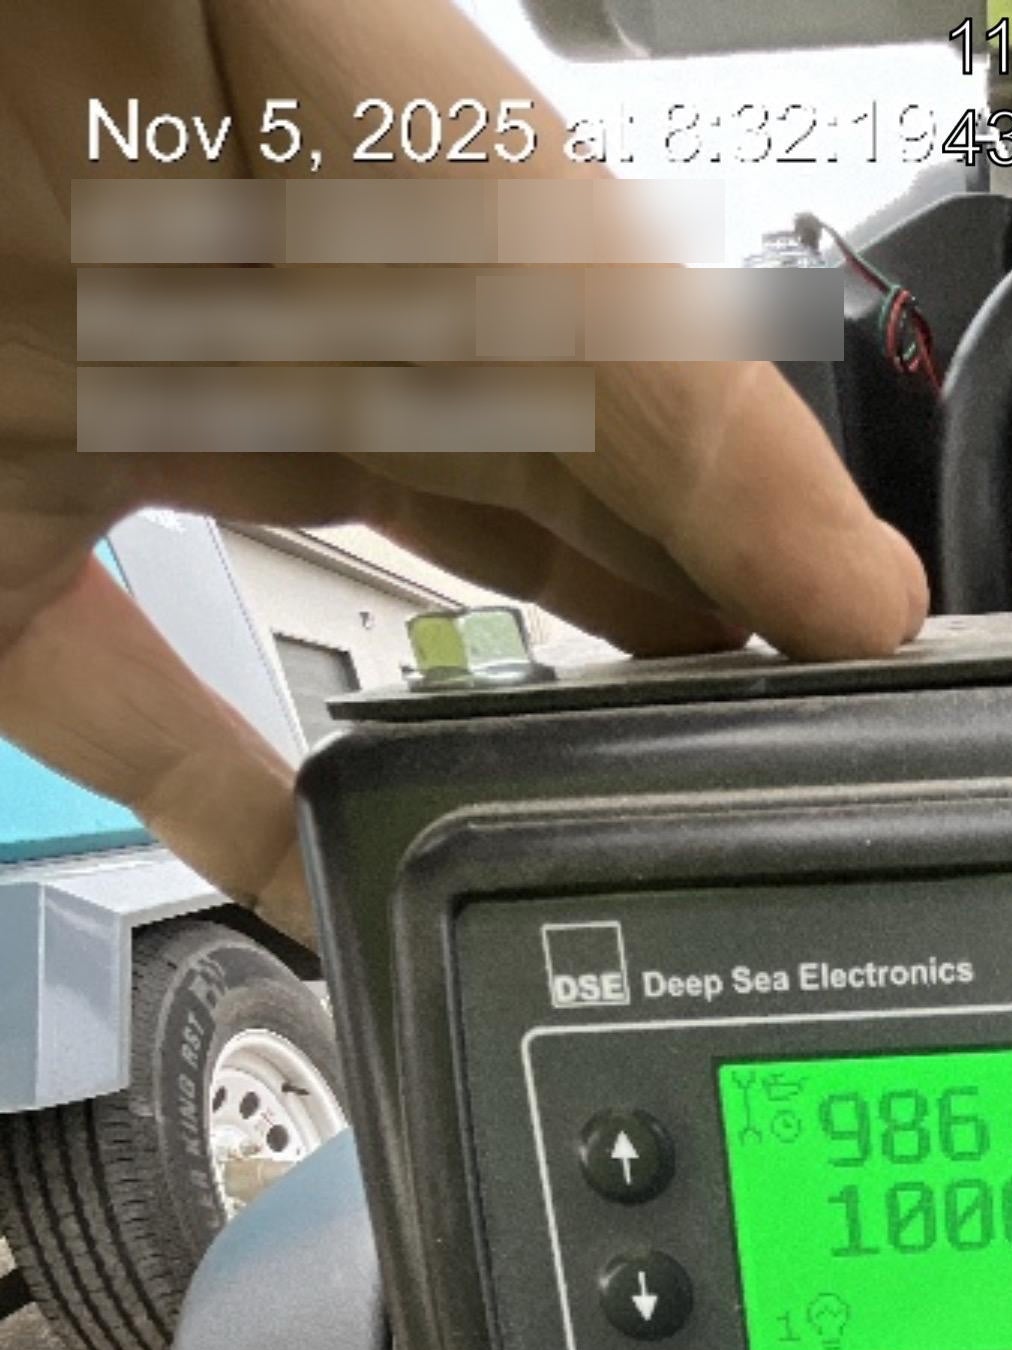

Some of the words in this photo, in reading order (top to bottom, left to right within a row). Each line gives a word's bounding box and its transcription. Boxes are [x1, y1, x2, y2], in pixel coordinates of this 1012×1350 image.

[552, 973, 626, 1002] DSE
[642, 969, 724, 1002] Deep
[731, 964, 790, 995] Sea
[799, 956, 974, 991] Electronics
